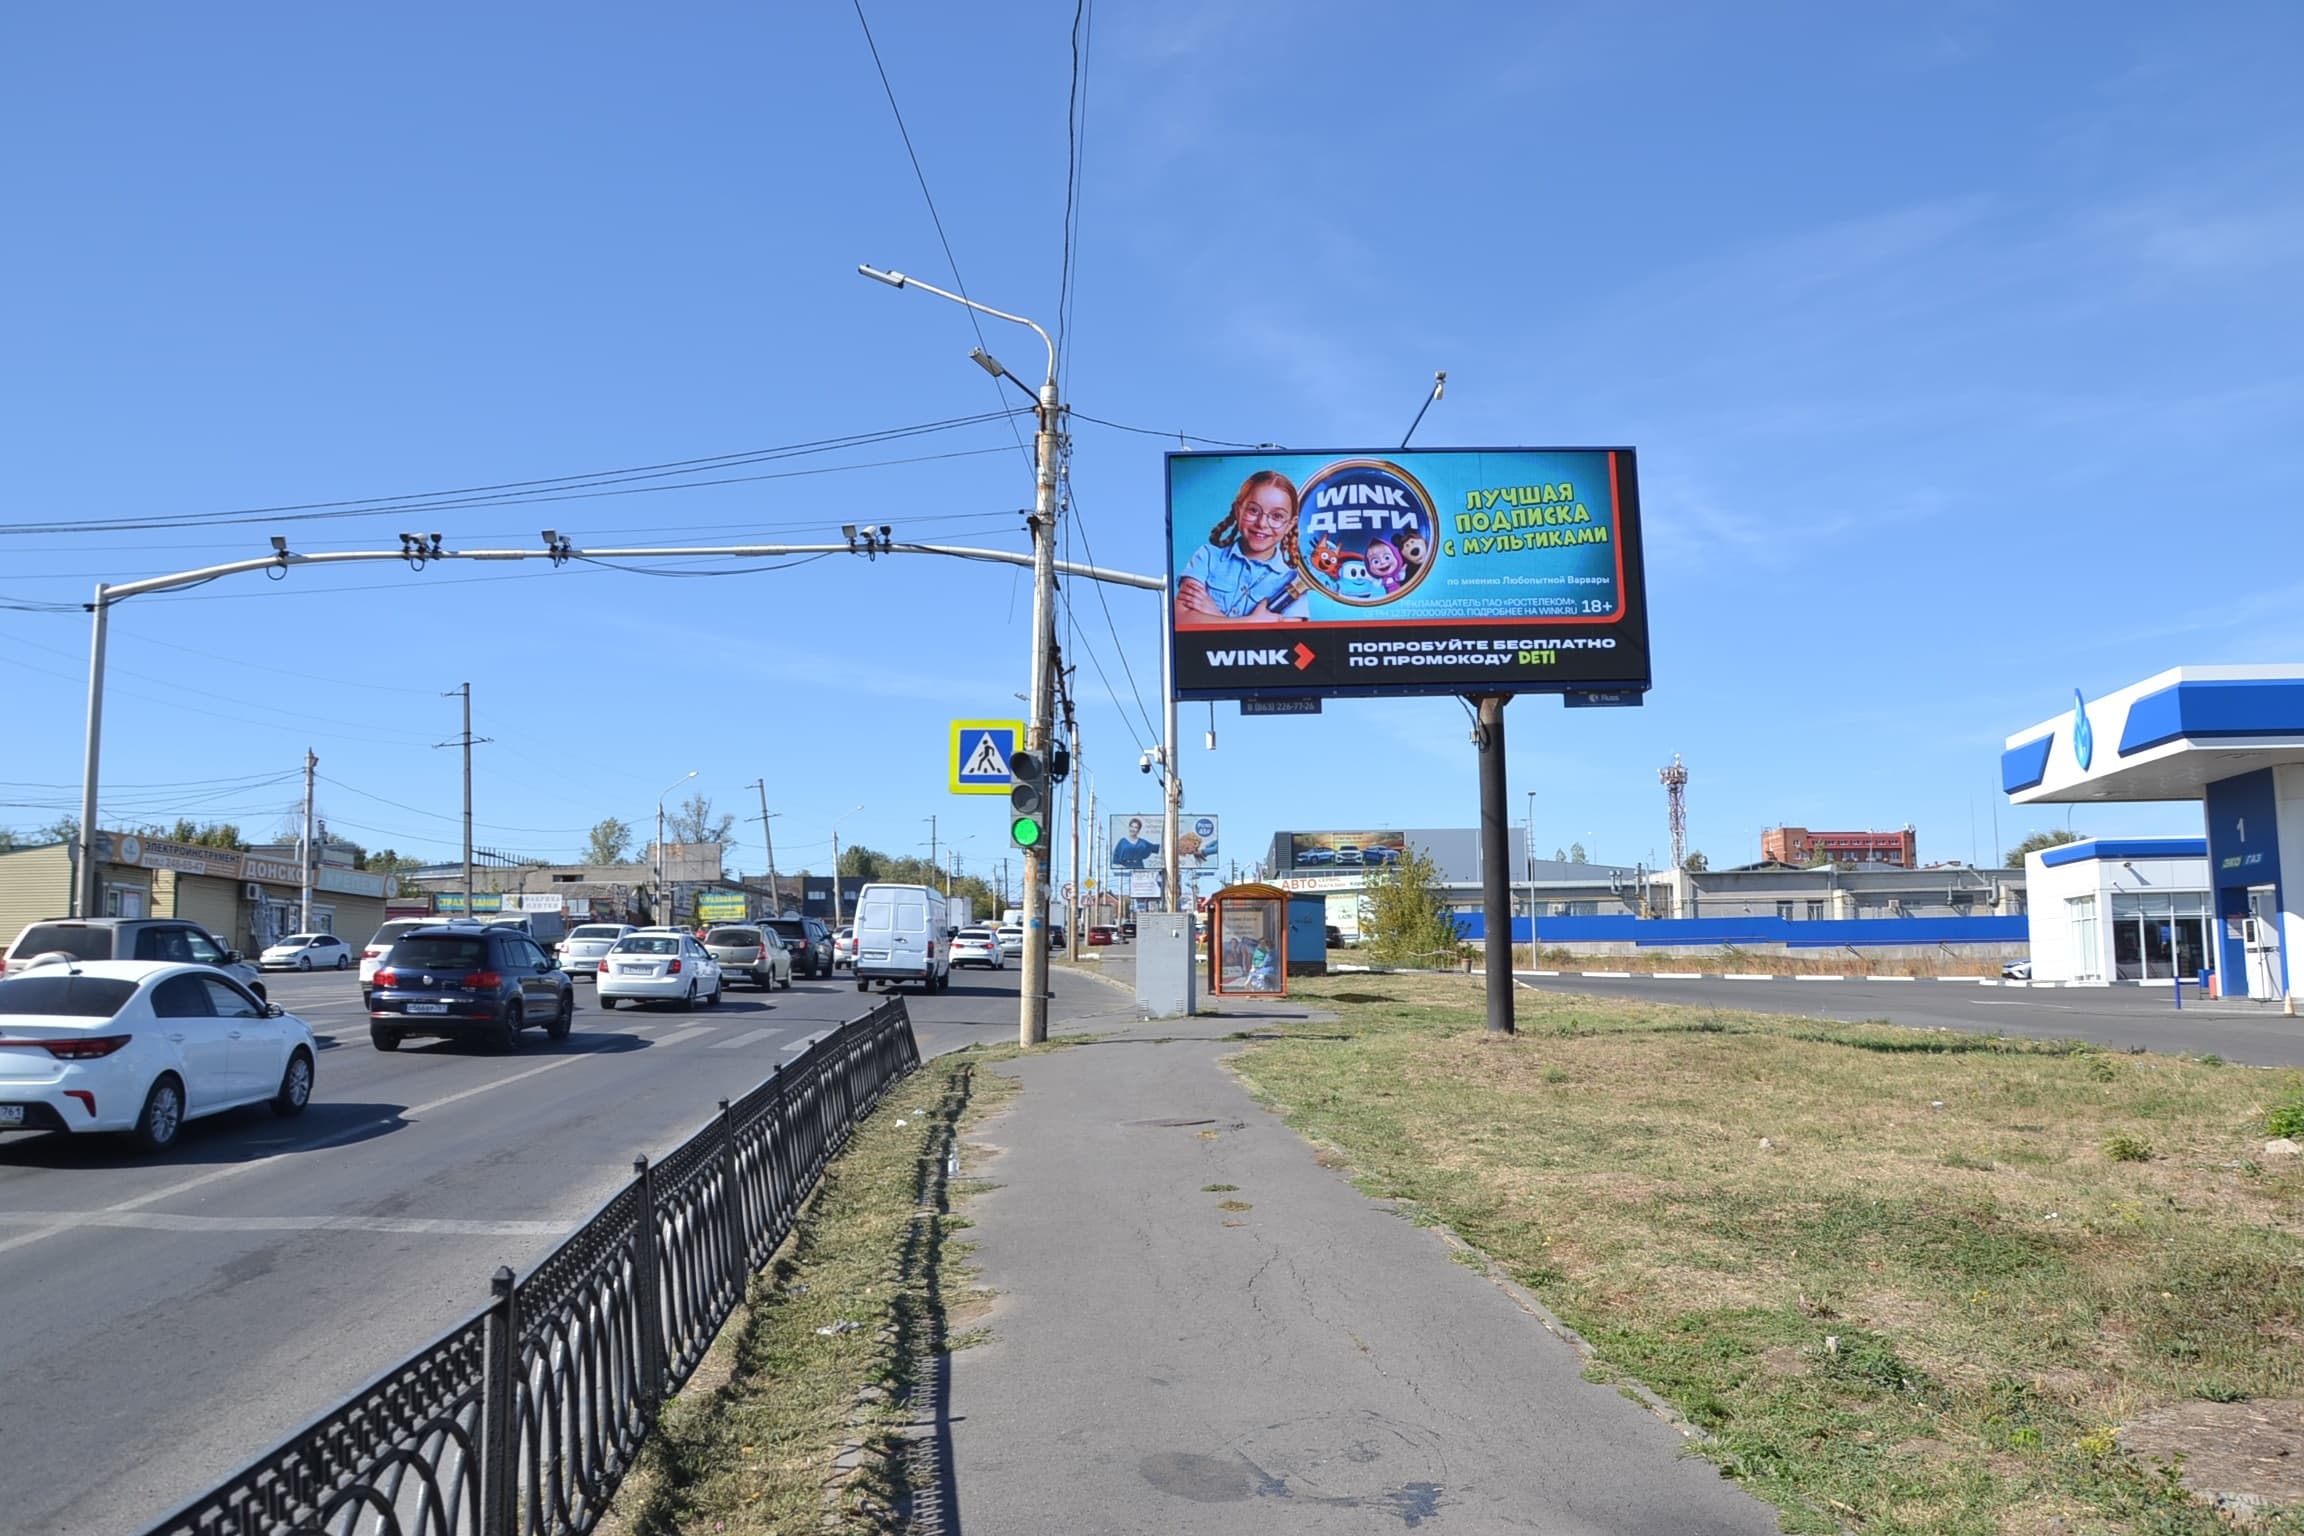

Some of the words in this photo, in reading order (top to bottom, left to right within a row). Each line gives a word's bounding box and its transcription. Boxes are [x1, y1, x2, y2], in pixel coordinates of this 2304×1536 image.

[1317, 484, 1410, 508] WINK
[1466, 482, 1574, 510] ЛУЧШАЯ
[1307, 509, 1419, 534] ДЕТИ
[1455, 503, 1591, 534] ПОДПИСКА
[1463, 526, 1609, 556] МУЛЬТИКАМИ
[1447, 578, 1459, 586] по
[1461, 577, 1501, 585] мнению
[1502, 575, 1565, 585] Любопытной
[1567, 575, 1610, 586] Варвары
[1467, 607, 1523, 616] ПОДРОБНЕЕ
[1524, 606, 1537, 615] НА
[1537, 606, 1578, 615] WINK.RU
[1482, 598, 1501, 607] ПАО
[1581, 599, 1613, 613] 18+
[1349, 639, 1489, 653] ПОПРОБУЙТЕ
[1493, 638, 1617, 650] БЕСПЛАТНО
[1206, 649, 1290, 666] WINK
[1350, 655, 1379, 667] ПО
[1383, 653, 1513, 667] ПРОМОКОДУ
[1518, 650, 1556, 665] DETI
[1276, 701, 1315, 711] 226-77-26
[2236, 817, 2245, 842] 1
[145, 841, 241, 863] ЭЛЕКТРОИНСТРУМЕНТ
[2245, 853, 2263, 865] ГАЗ
[246, 861, 315, 884] ДОНСКО
[1281, 878, 1317, 890] АВТО
